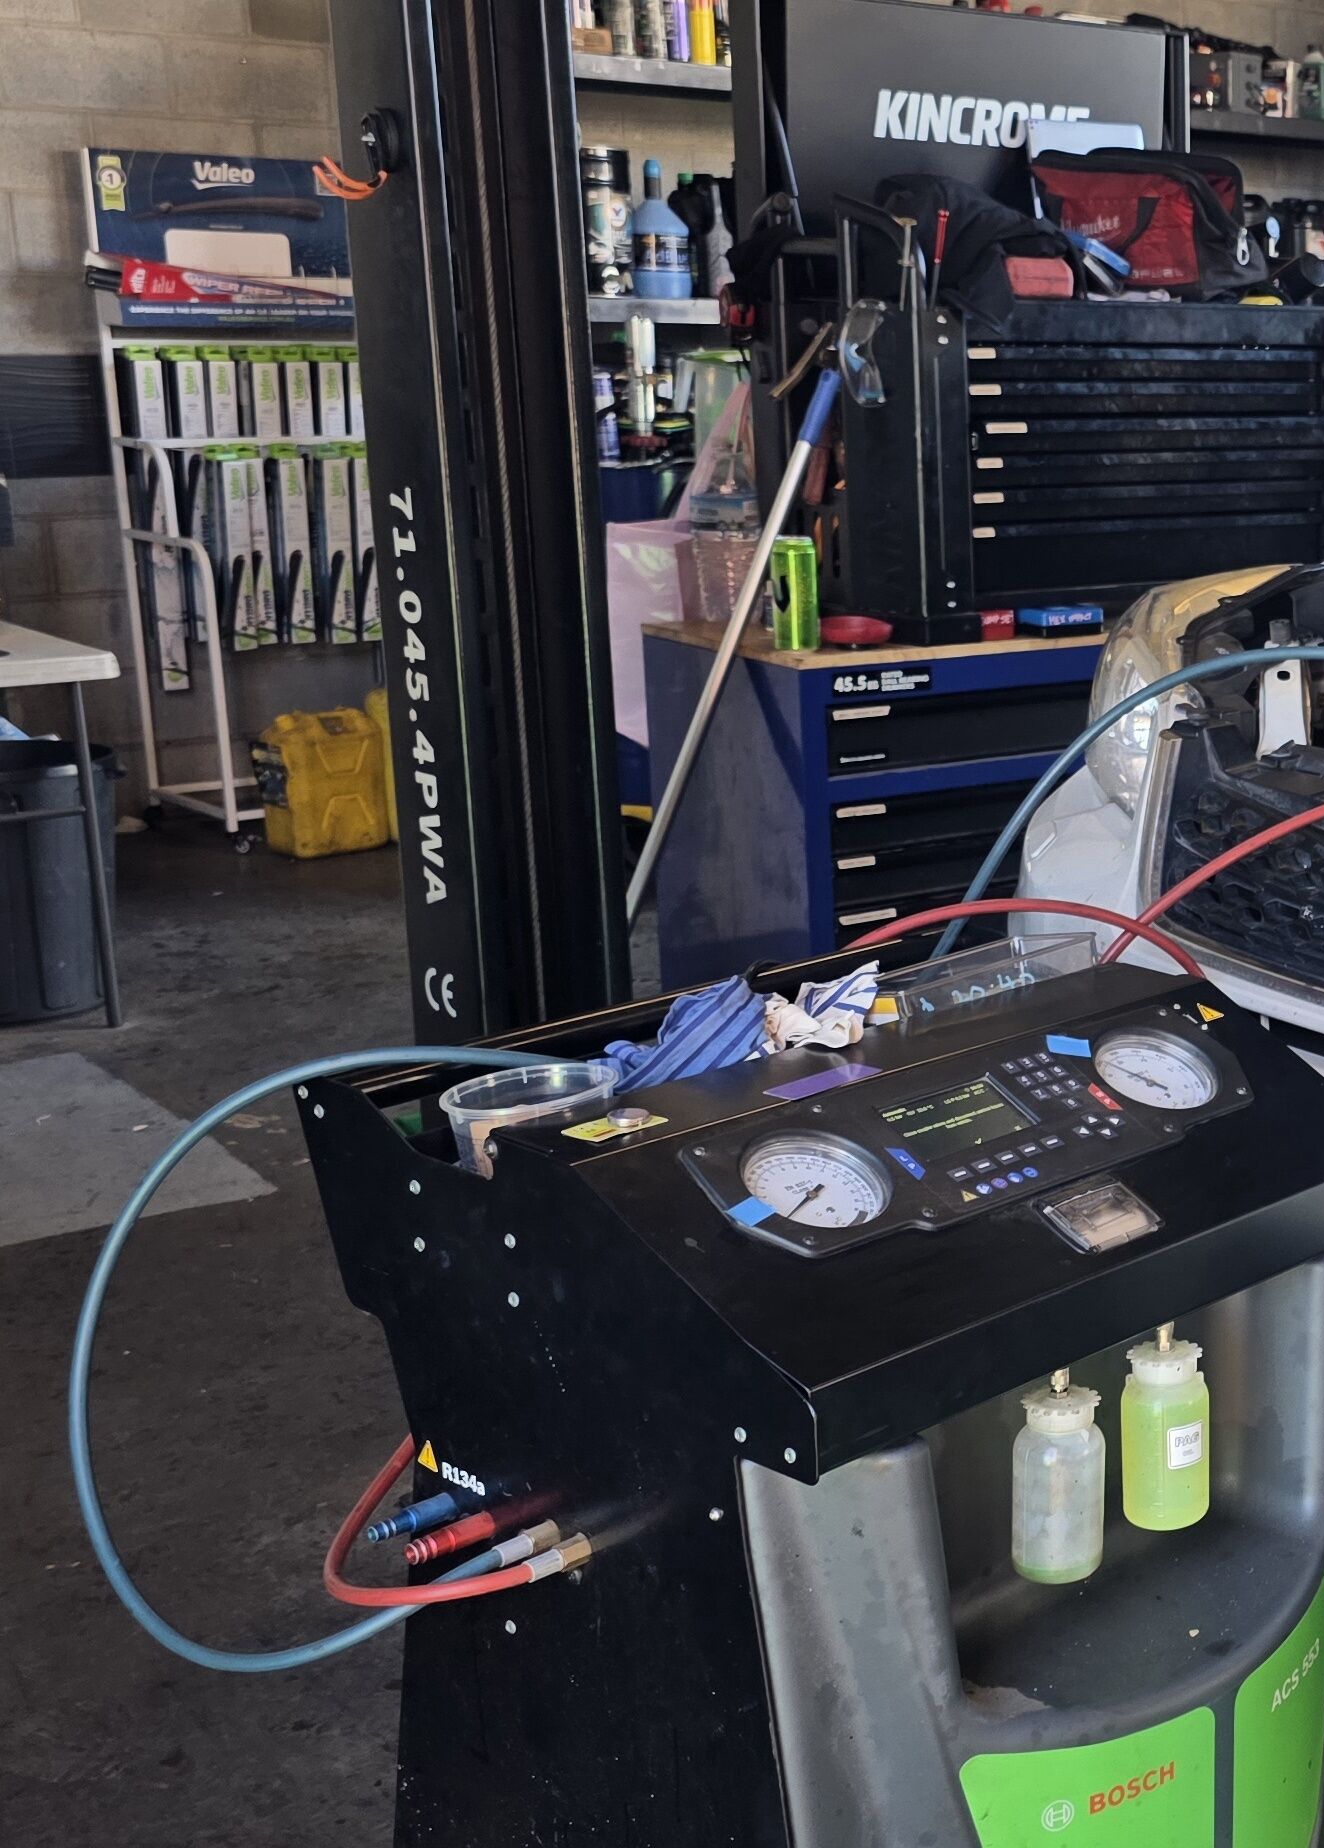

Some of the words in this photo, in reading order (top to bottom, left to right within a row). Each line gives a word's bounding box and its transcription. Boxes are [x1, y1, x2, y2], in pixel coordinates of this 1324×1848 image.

[874, 88, 1090, 149] KINCRO
[193, 160, 255, 184] Valeo
[389, 486, 449, 904] 71.045.4PWA
[441, 1461, 486, 1497] R134a
[1271, 1668, 1300, 1713] ACS
[1302, 1637, 1320, 1678] 553
[1089, 1760, 1175, 1815] BOSCH
